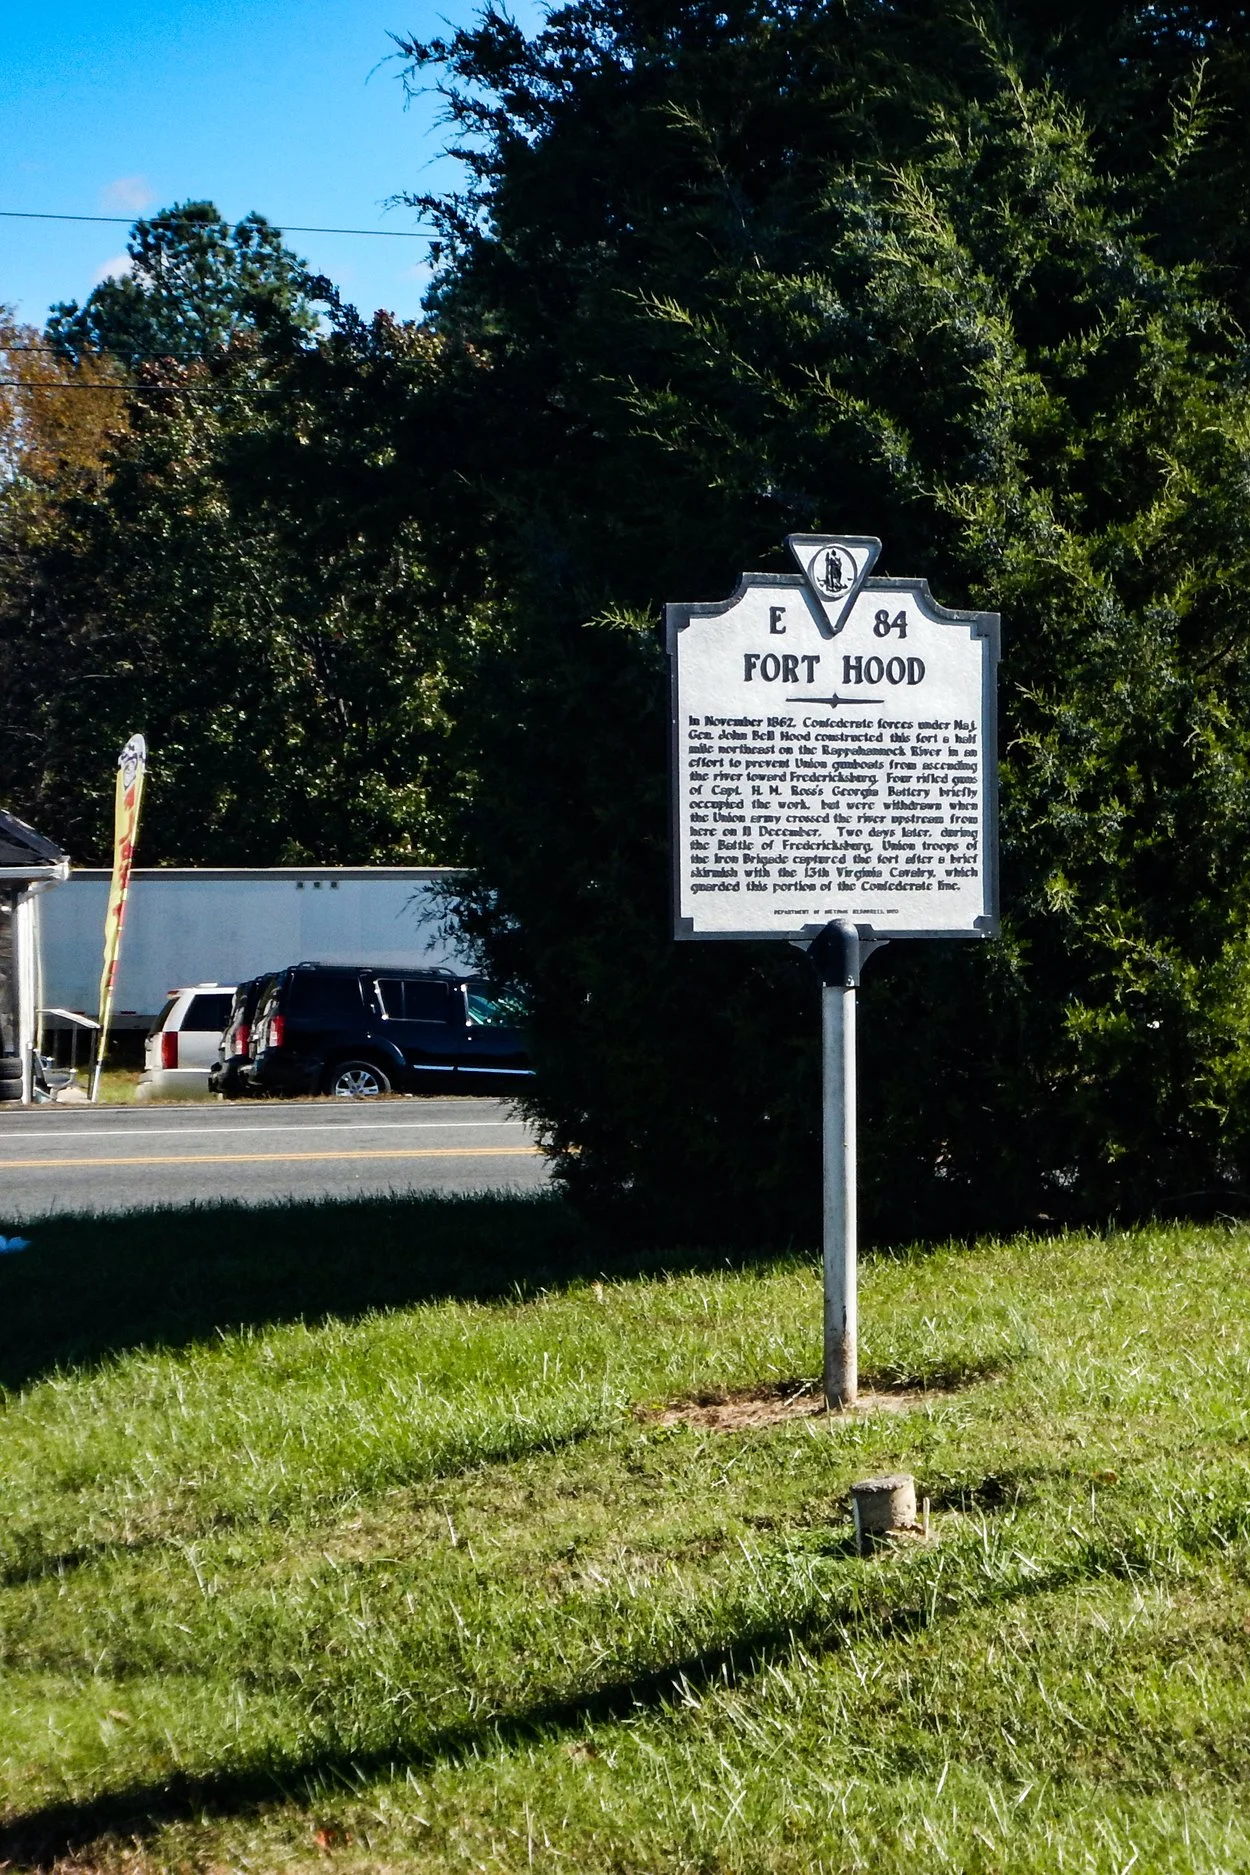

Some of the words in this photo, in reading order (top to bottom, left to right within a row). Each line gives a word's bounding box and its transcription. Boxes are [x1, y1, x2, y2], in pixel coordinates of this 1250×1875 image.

[769, 606, 786, 634] E
[873, 609, 907, 639] 84
[743, 653, 820, 682] FORT
[842, 655, 926, 685] HOOD
[688, 716, 699, 726] In
[704, 716, 763, 727] November
[802, 717, 873, 728] Confederate
[877, 718, 913, 729] forces
[917, 719, 950, 729] under
[718, 730, 747, 740] John
[751, 730, 774, 741] Bell
[780, 731, 810, 741] Hood
[814, 731, 882, 742] constructed
[889, 732, 910, 742] this
[915, 732, 937, 742] fort
[942, 735, 949, 743] a
[955, 733, 976, 743] half
[688, 743, 714, 754] mile
[717, 744, 775, 754] northeast
[778, 747, 793, 755] on
[798, 744, 817, 755] the
[821, 745, 906, 758] Rappahannock
[910, 746, 941, 756] River
[948, 746, 958, 756] in
[688, 757, 724, 768] effort
[729, 757, 741, 768] to
[745, 758, 789, 771] prevent
[795, 758, 827, 769] Union
[831, 758, 884, 771] gunboats
[889, 759, 916, 769] from
[922, 759, 977, 772] ascending
[689, 771, 709, 781] the
[713, 771, 743, 782] river
[746, 771, 786, 782] toward
[886, 772, 912, 783] Four
[916, 773, 948, 783] rifled
[951, 776, 977, 785] guns
[689, 785, 703, 795] of
[832, 786, 878, 798] Georgia
[887, 786, 930, 799] Battery
[939, 786, 977, 799] briefly
[689, 798, 743, 811] occupied
[751, 799, 770, 809] the
[821, 799, 839, 809] but
[883, 799, 941, 810] withdrawn
[949, 800, 977, 810] when
[689, 812, 708, 822] the
[713, 812, 745, 823] Union
[750, 815, 781, 825] army
[785, 813, 829, 823] crossed
[833, 813, 852, 823] the
[857, 813, 886, 823] river
[891, 813, 943, 825] upstream
[950, 813, 977, 823] from
[689, 826, 717, 836] here
[742, 826, 751, 836] 11
[836, 826, 862, 837] Two
[868, 826, 895, 839] days
[940, 827, 978, 839] during
[689, 840, 709, 850] the
[717, 840, 753, 850] Battle
[761, 840, 774, 850] of
[882, 840, 915, 850] Union
[922, 840, 958, 852] troops
[966, 840, 978, 850] of
[690, 853, 709, 864] the
[714, 853, 738, 864] Iron
[742, 853, 788, 866] Brigade
[792, 853, 846, 866] captured
[852, 853, 871, 864] the
[877, 853, 898, 864] fort
[905, 853, 933, 864] after
[938, 856, 944, 864] a
[950, 853, 978, 864] brief
[690, 867, 737, 877] skirmish
[744, 867, 770, 877] with
[777, 867, 797, 877] the
[804, 867, 829, 877] 13th
[836, 867, 882, 879] Virginia
[944, 867, 978, 877] which
[690, 881, 740, 893] guarded
[745, 881, 767, 891] this
[772, 881, 816, 893] portion
[819, 881, 832, 891] of
[837, 881, 855, 891] the
[861, 880, 932, 891] Confederate
